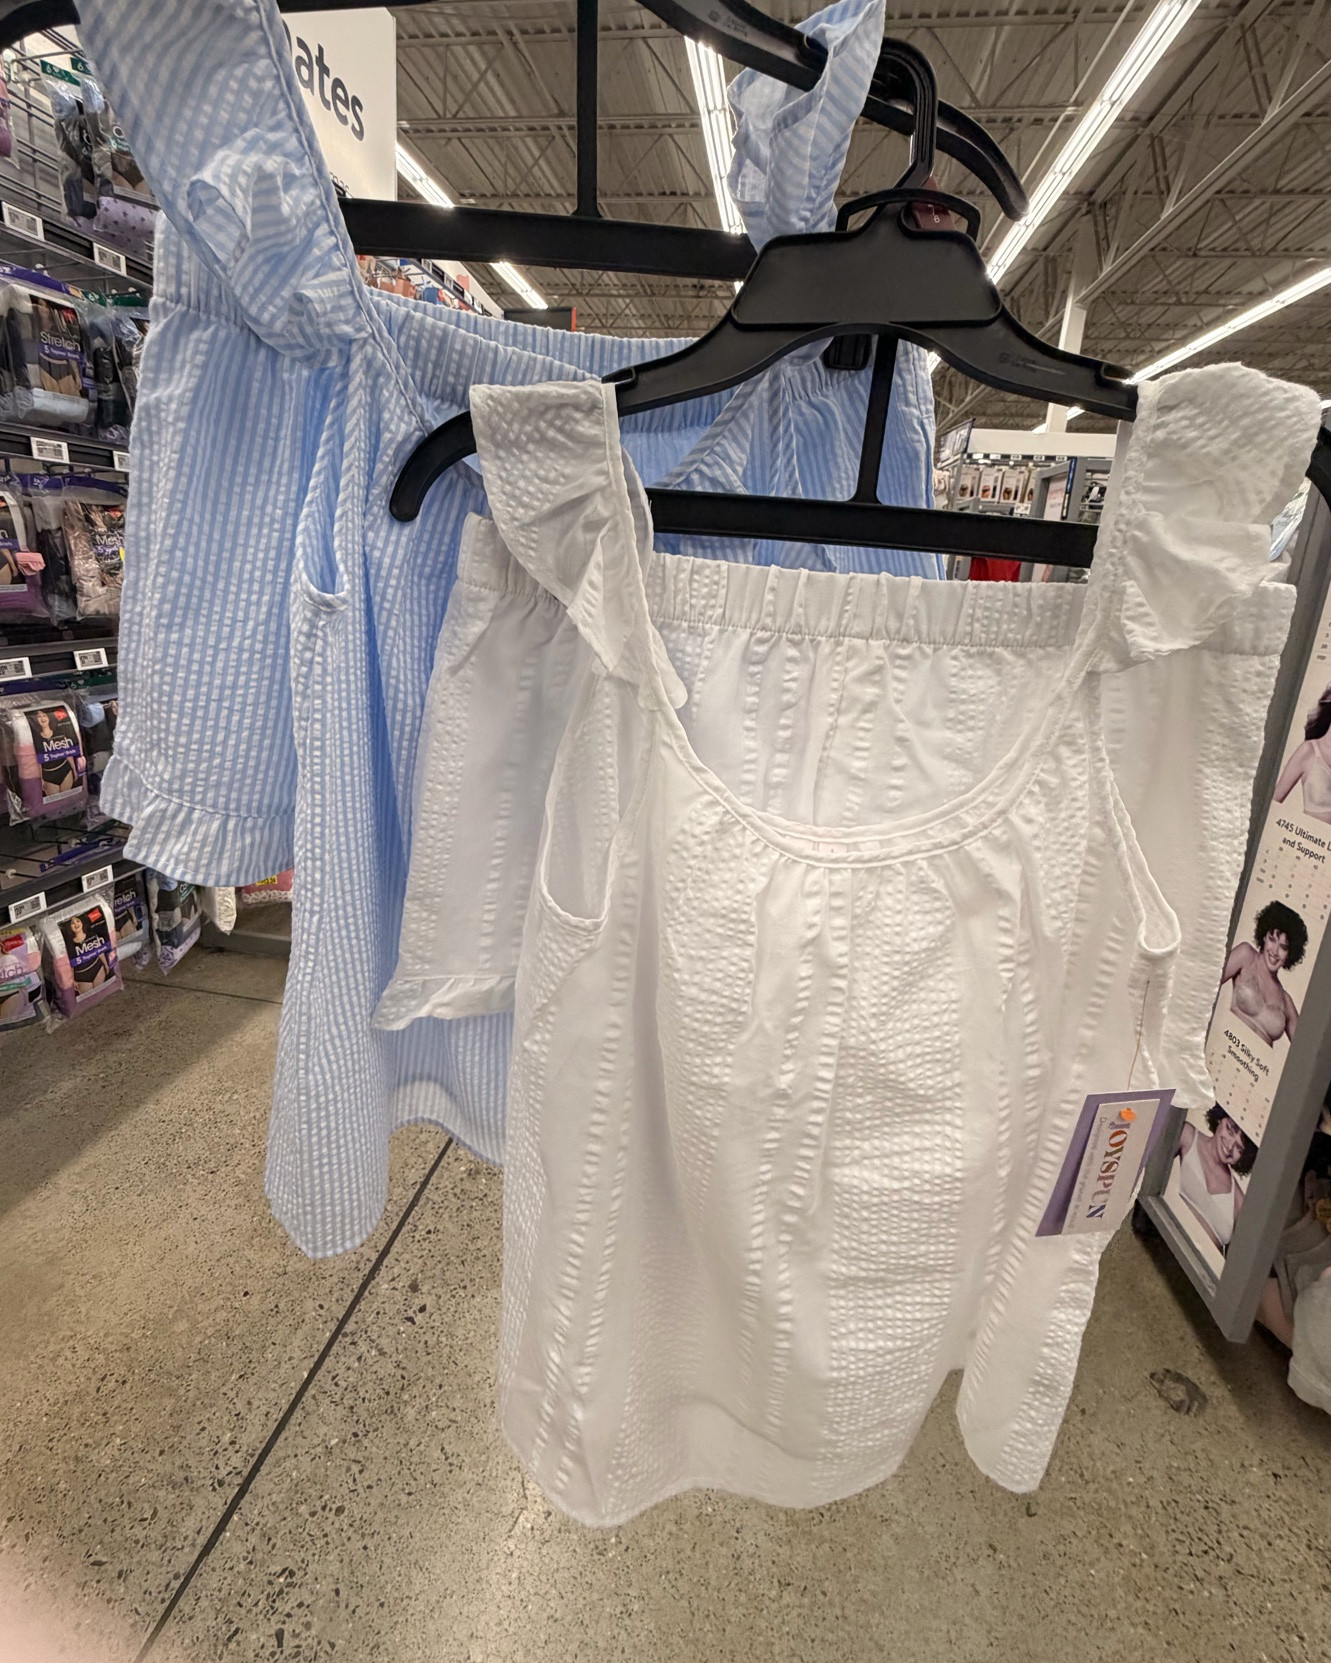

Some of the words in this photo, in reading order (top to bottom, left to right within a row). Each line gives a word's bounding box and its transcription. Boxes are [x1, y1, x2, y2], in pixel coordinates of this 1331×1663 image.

[40, 331, 81, 352] Stretch
[42, 736, 74, 753] Mesh
[43, 753, 50, 762] 5
[1275, 818, 1295, 833] 4745
[1294, 825, 1327, 849] Ultimate
[1282, 837, 1297, 849] and
[1296, 841, 1327, 864] Support
[114, 889, 137, 907] retch
[75, 934, 106, 957] Mesh
[1223, 1029, 1241, 1048] 4803
[1255, 1057, 1270, 1077] Soft
[1227, 1044, 1260, 1083] Smoothing
[1086, 1121, 1131, 1219] JOYSPUN
